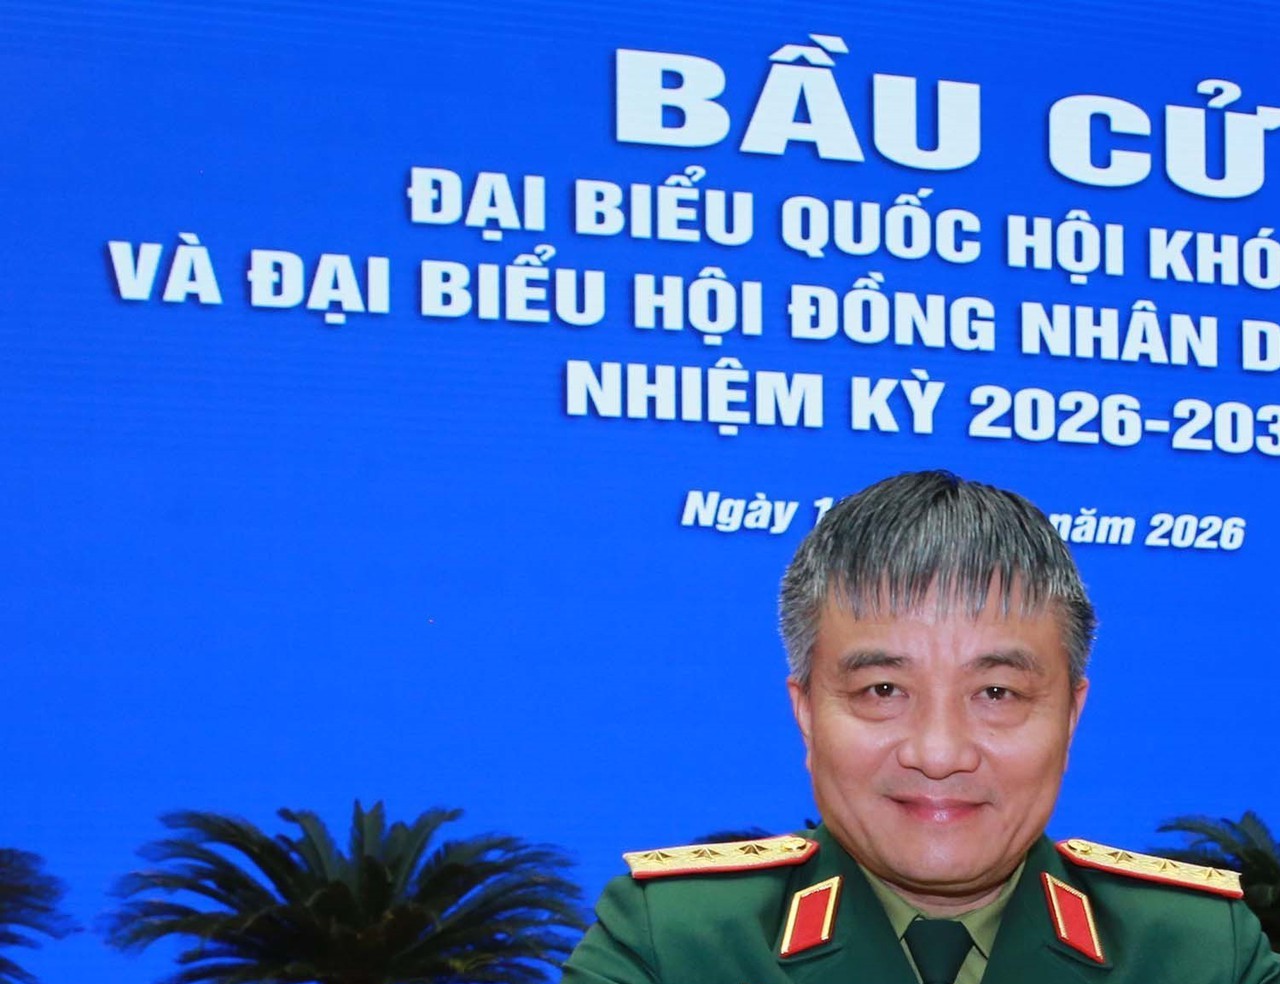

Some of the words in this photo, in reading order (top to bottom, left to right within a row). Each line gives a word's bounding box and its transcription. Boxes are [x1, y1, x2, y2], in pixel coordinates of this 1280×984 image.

[616, 34, 981, 170] BẦU
[407, 166, 545, 241] ĐẠI
[575, 165, 753, 245] BIỂU
[782, 187, 981, 263] QUỐC
[1007, 209, 1124, 284] HỘI
[108, 232, 222, 304] VÀ
[247, 249, 390, 324] ĐẠI
[421, 244, 605, 325] BIỂU
[634, 266, 762, 345] HỘI
[787, 271, 995, 351] ĐỒNG
[1021, 299, 1218, 367] NHÂN
[566, 356, 823, 436] NHIỆM
[851, 368, 945, 434] KỲ
[681, 490, 799, 534] Ngày
[1048, 507, 1136, 545] năm
[1144, 513, 1246, 550] 2026
